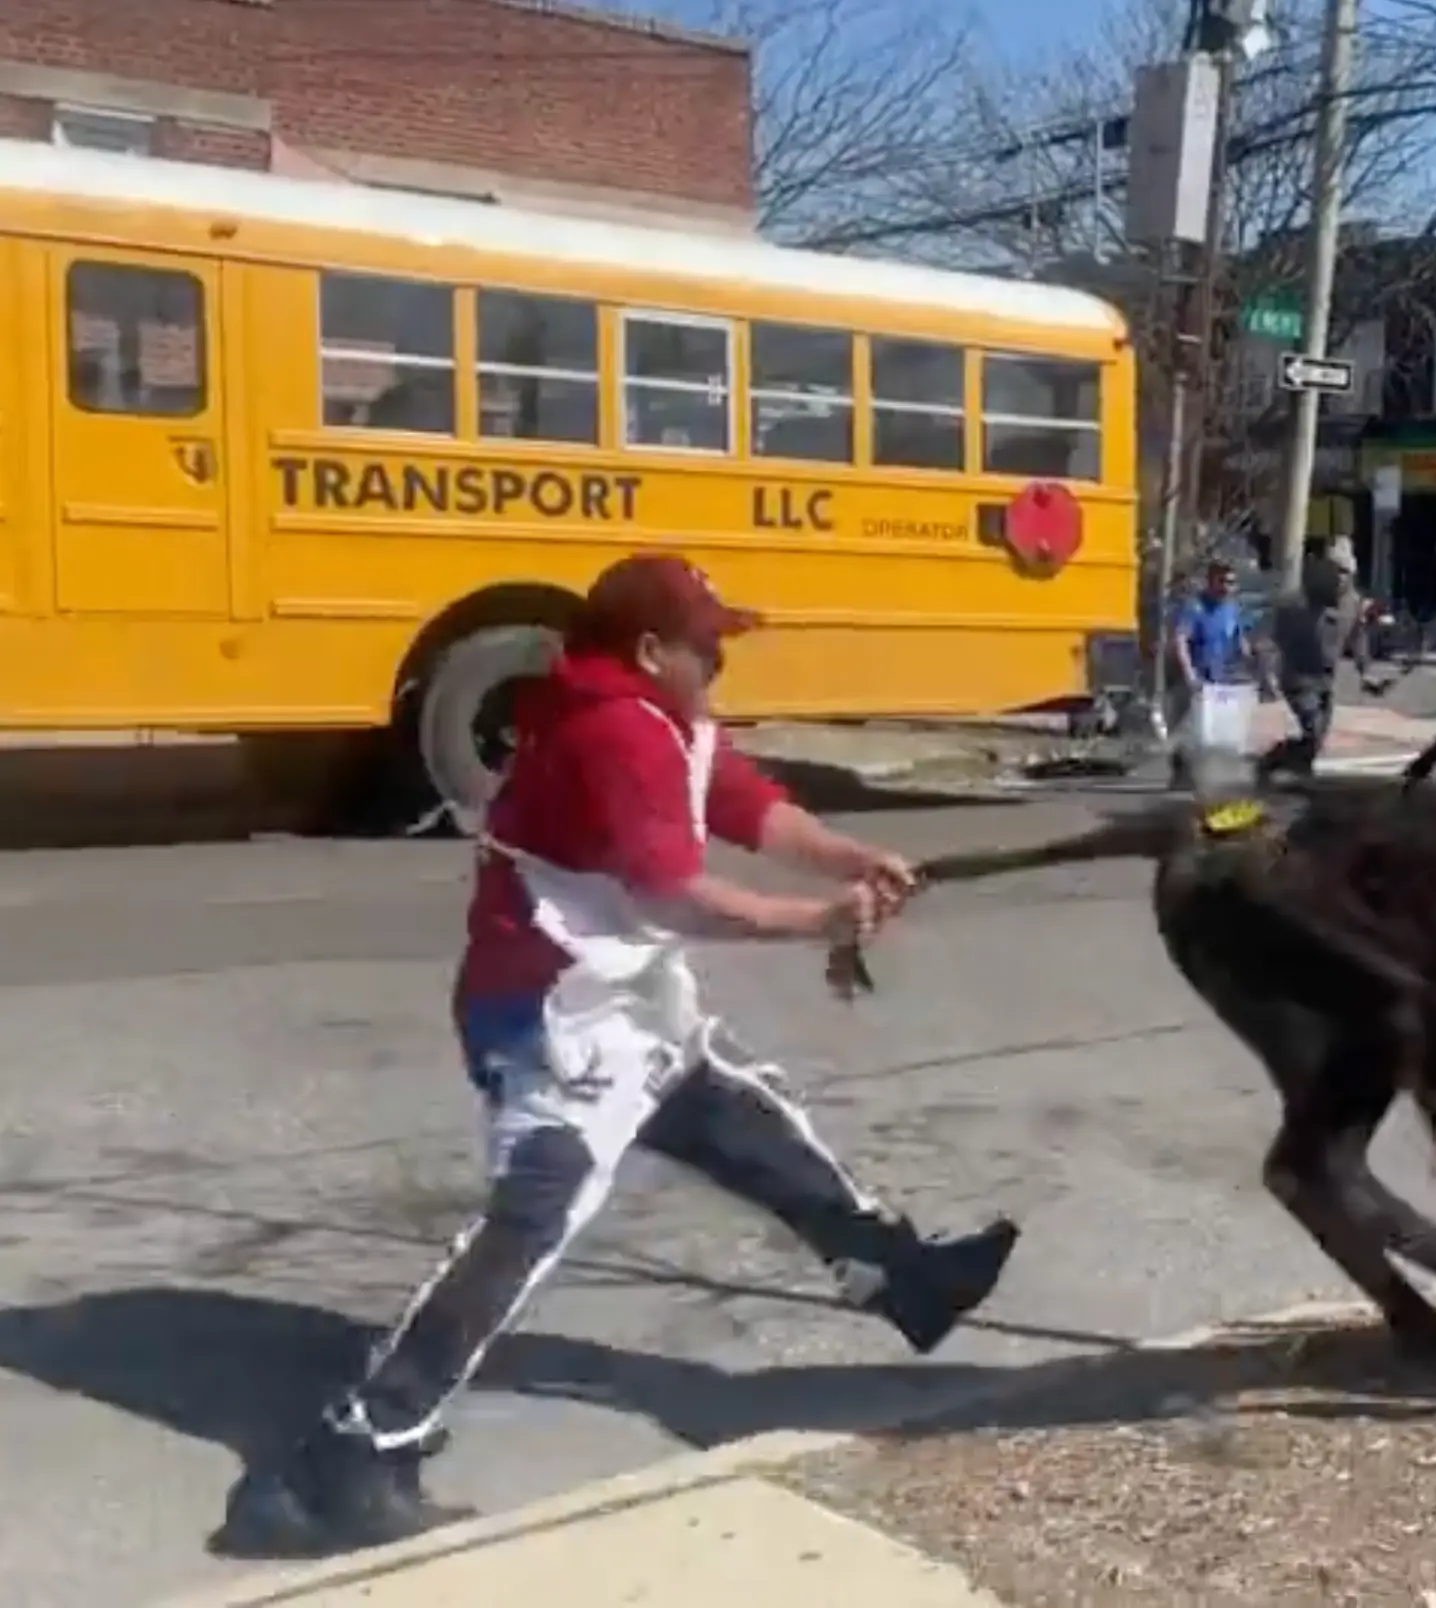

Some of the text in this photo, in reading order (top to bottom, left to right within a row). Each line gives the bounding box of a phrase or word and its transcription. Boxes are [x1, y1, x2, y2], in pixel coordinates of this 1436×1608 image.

[271, 457, 835, 531] TRANSPORT LLC
[862, 517, 969, 541] OPERATOR
